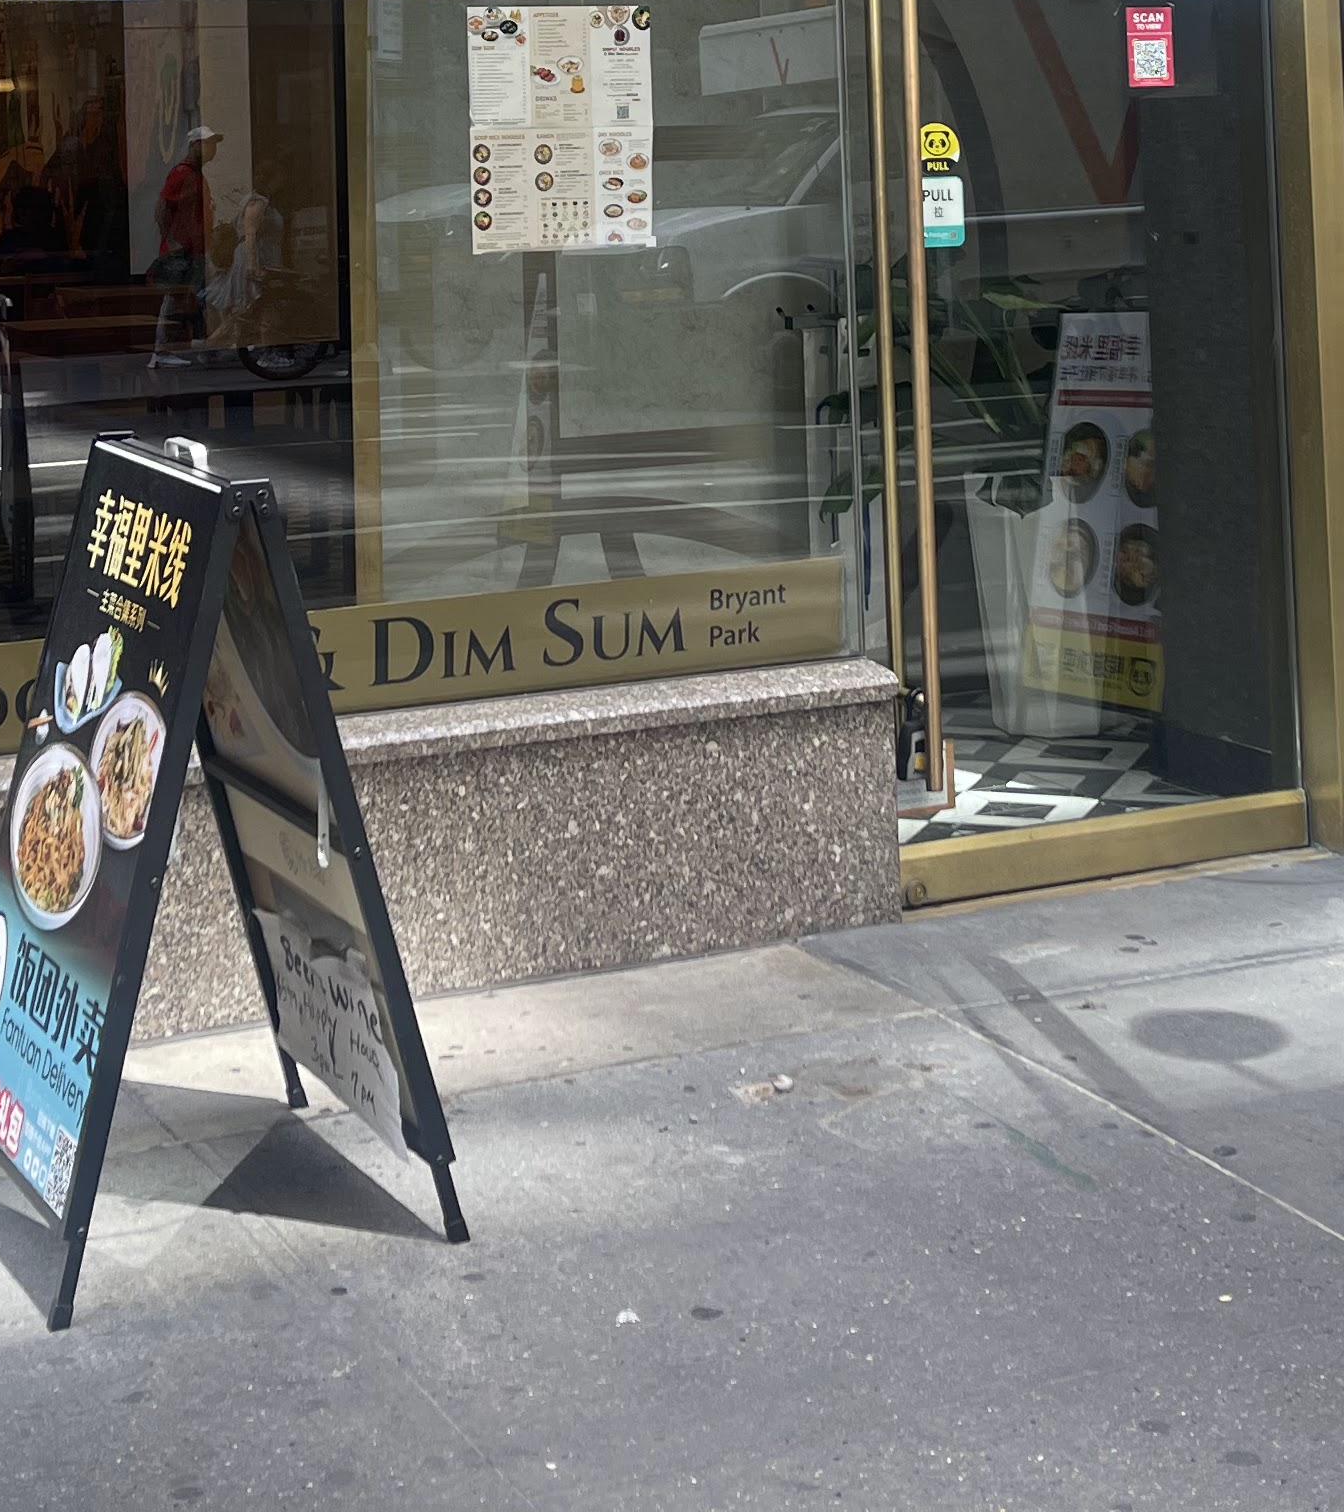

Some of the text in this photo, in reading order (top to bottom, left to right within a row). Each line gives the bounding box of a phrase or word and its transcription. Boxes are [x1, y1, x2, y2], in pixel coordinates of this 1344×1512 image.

[1132, 12, 1164, 23] SCAN
[926, 161, 950, 171] PULL
[923, 189, 954, 201] PULL
[86, 488, 193, 610] 幸福里米线
[709, 583, 787, 612] Bryant
[371, 615, 516, 687] DIM
[542, 598, 687, 668] SUM
[708, 621, 761, 648] Park
[9, 932, 107, 1080] 饭团外卖
[328, 975, 383, 1046] Wine
[0, 1007, 43, 1074] Fantuan
[41, 1055, 87, 1129] Delivery
